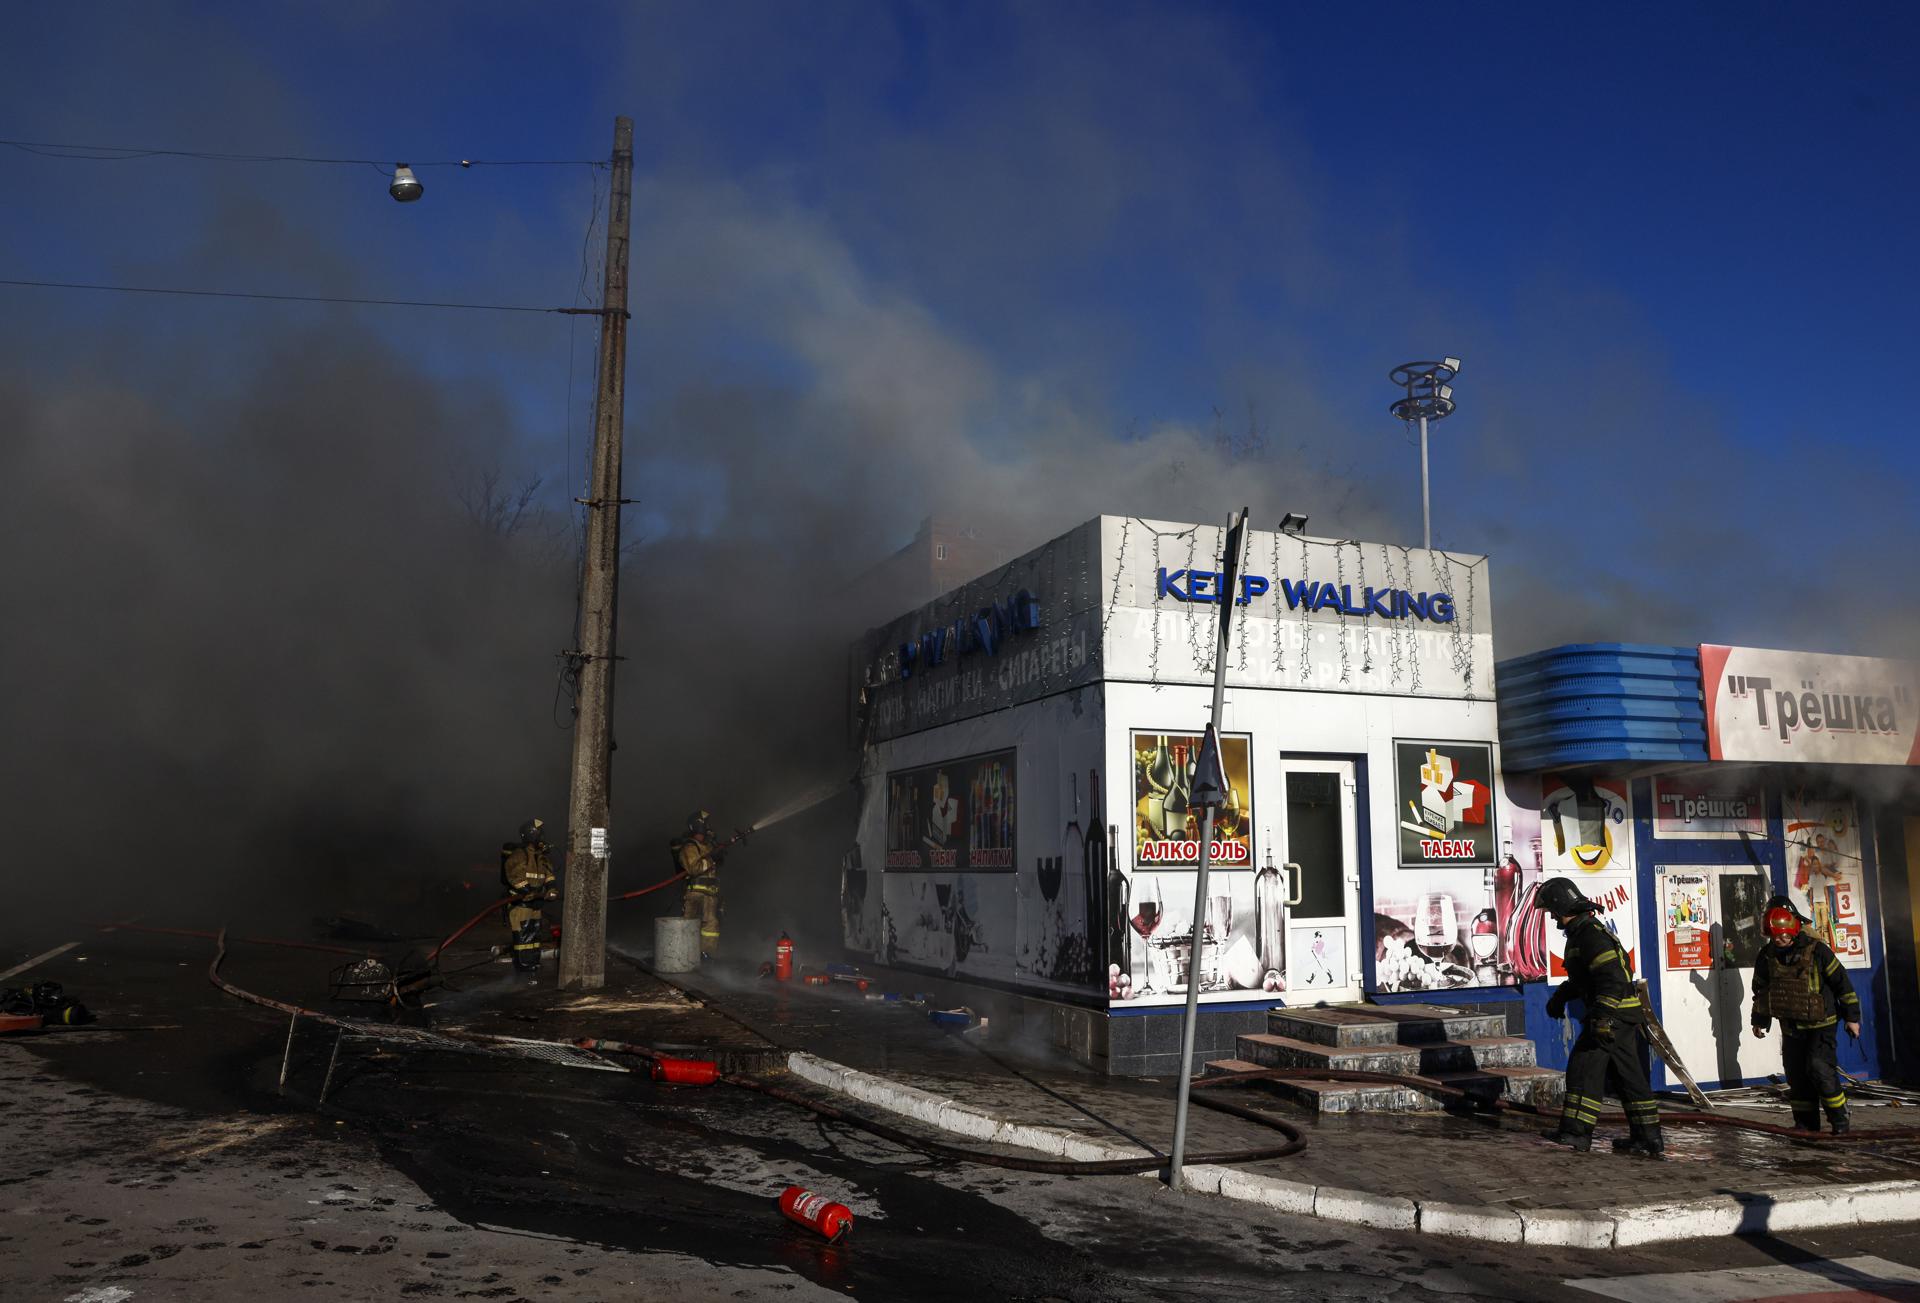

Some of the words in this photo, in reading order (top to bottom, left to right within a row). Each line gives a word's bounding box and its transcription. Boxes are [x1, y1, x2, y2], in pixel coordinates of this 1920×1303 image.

[1280, 578, 1454, 624] WALKING
[1141, 841, 1247, 860] АЛКООЛЬ
[1420, 840, 1475, 858] ТАБАК
[1655, 865, 1666, 875] 60
[1841, 894, 1851, 910] 3
[1850, 938, 1858, 950] 3
